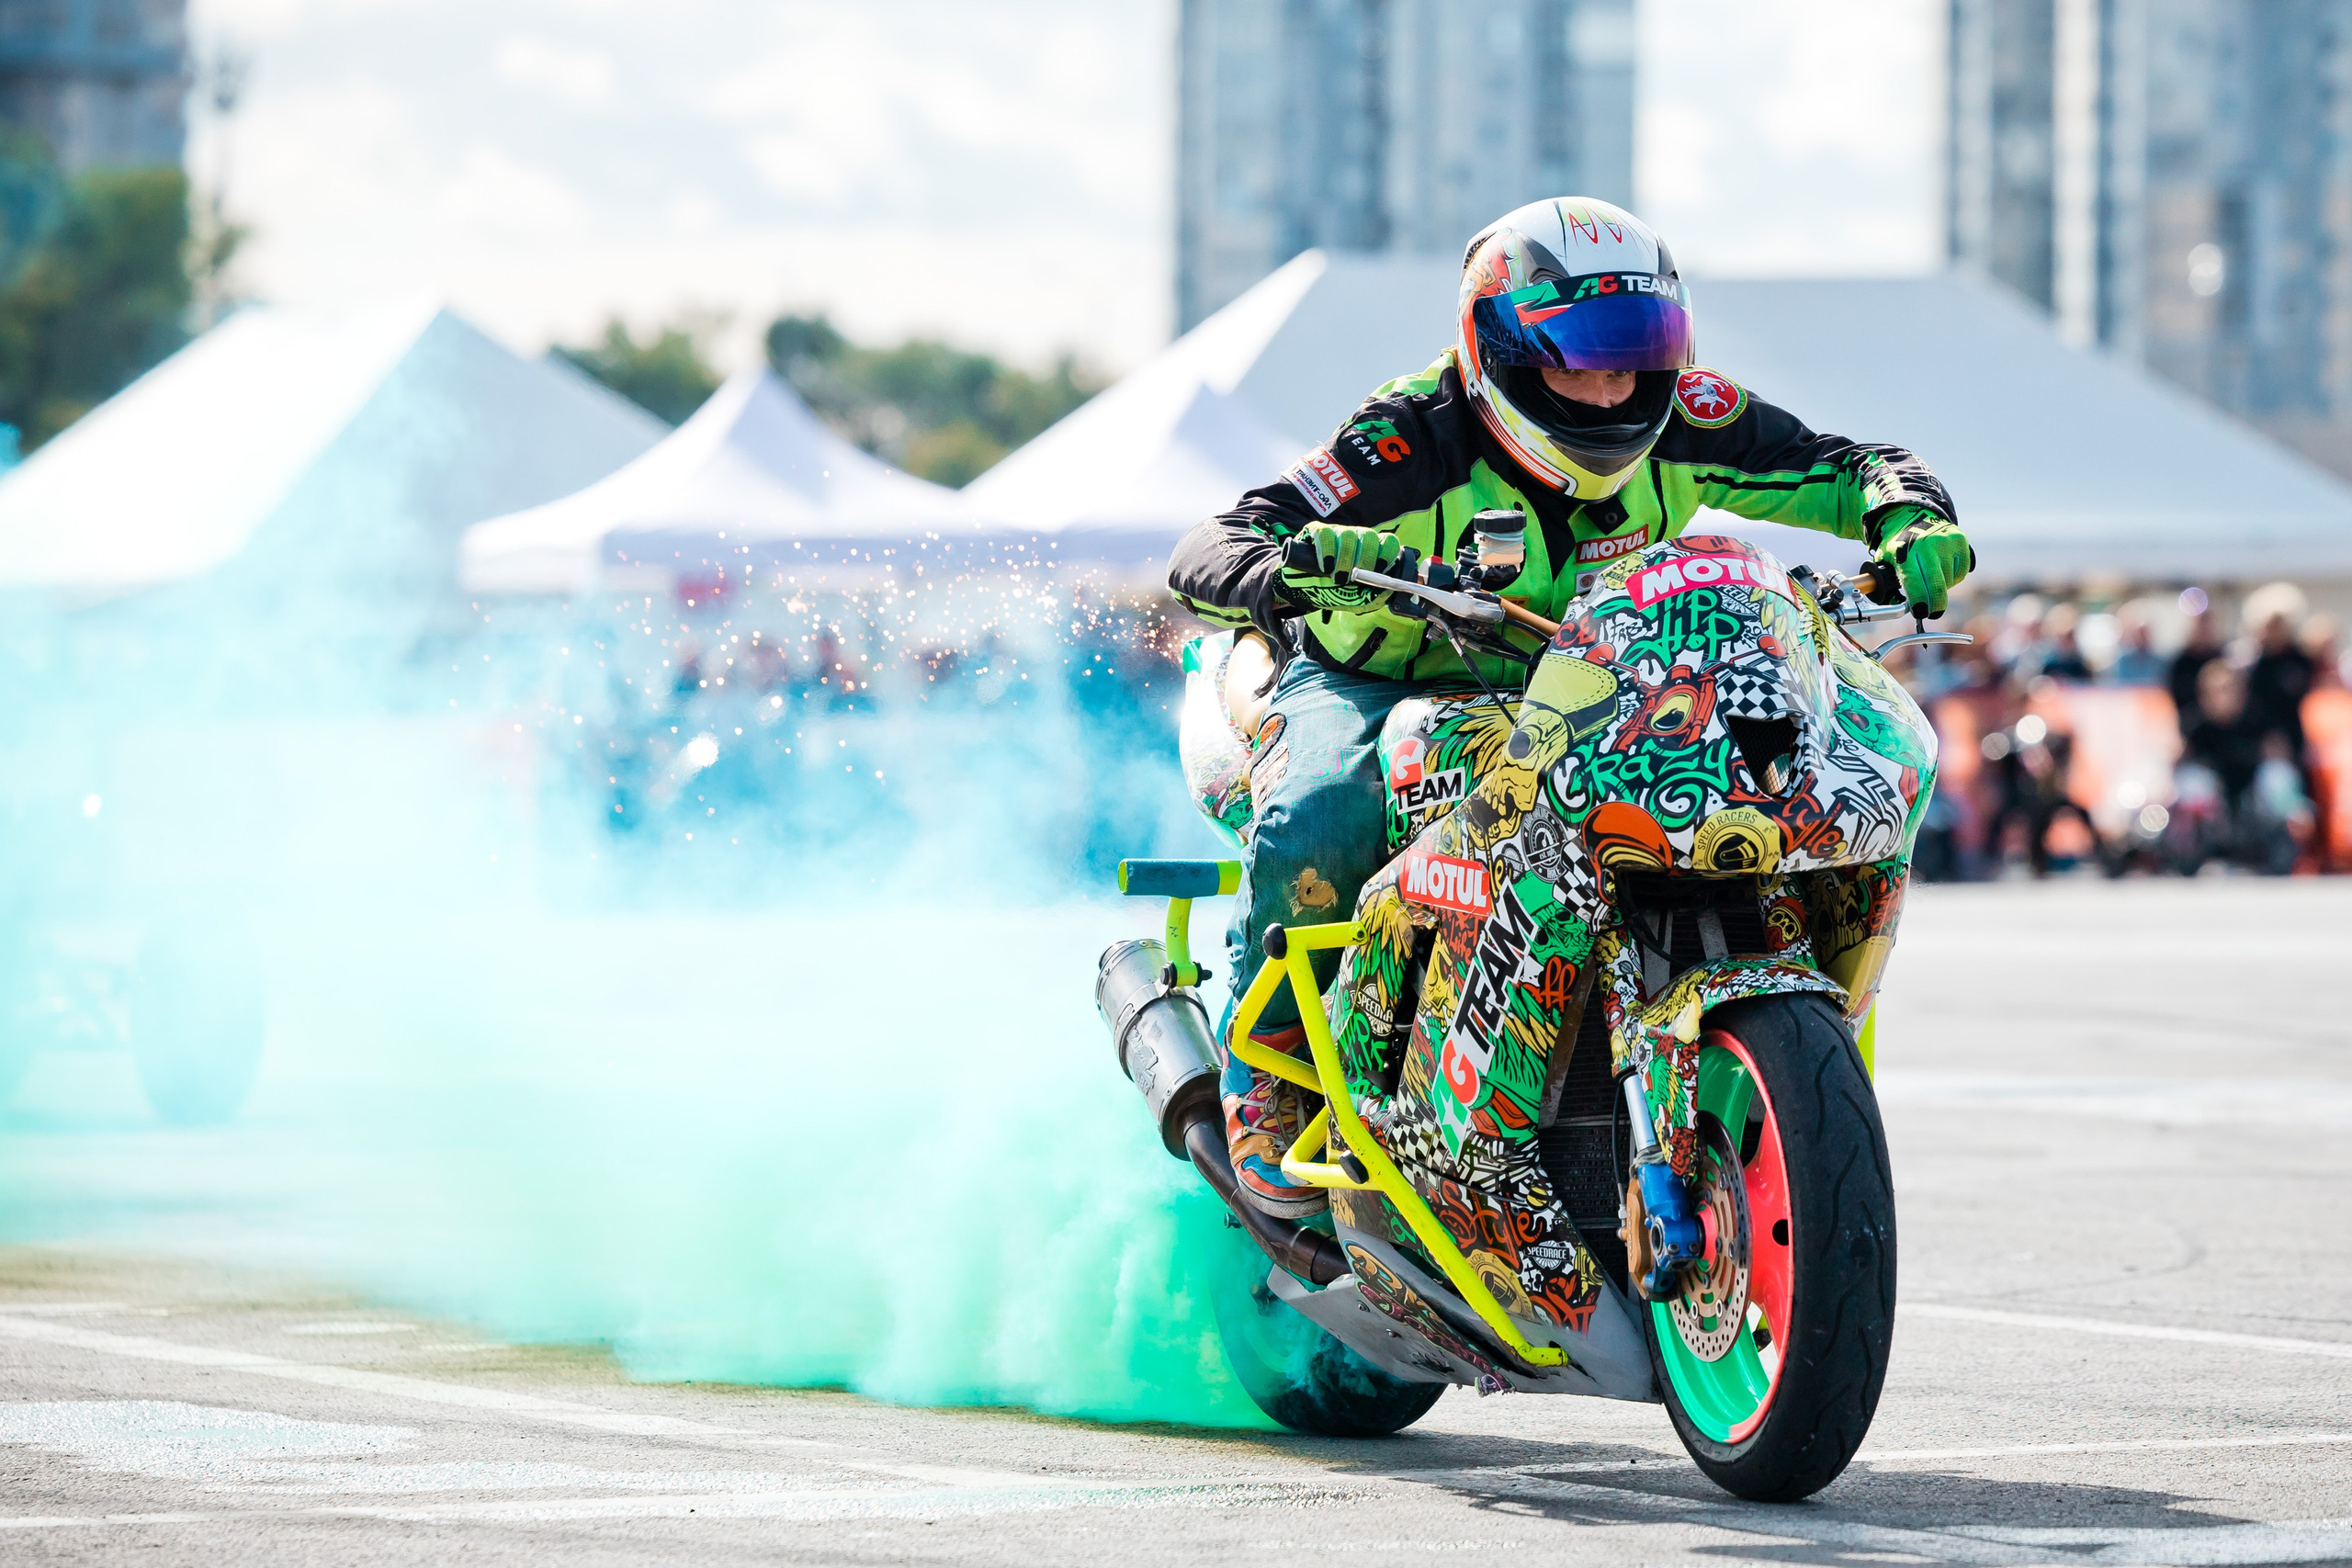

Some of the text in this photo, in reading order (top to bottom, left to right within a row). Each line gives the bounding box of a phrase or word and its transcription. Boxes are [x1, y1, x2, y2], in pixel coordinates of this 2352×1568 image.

[1573, 276, 1678, 300] AG TEAM
[1344, 431, 1381, 466] TEAM
[1295, 468, 1331, 510] ТРАНЗИТ-ОЙЛ
[1303, 448, 1354, 498] OTUL
[1579, 530, 1645, 560] MOTUL
[1641, 558, 1797, 604] MOTUL
[1395, 772, 1462, 810] TEAM
[1697, 811, 1758, 851] SPEED RACERS
[1407, 856, 1487, 908] MOTUL
[1455, 877, 1536, 1055] TEAM
[1439, 1180, 1544, 1269] Style
[1527, 1247, 1567, 1260] SPEEDRACE
